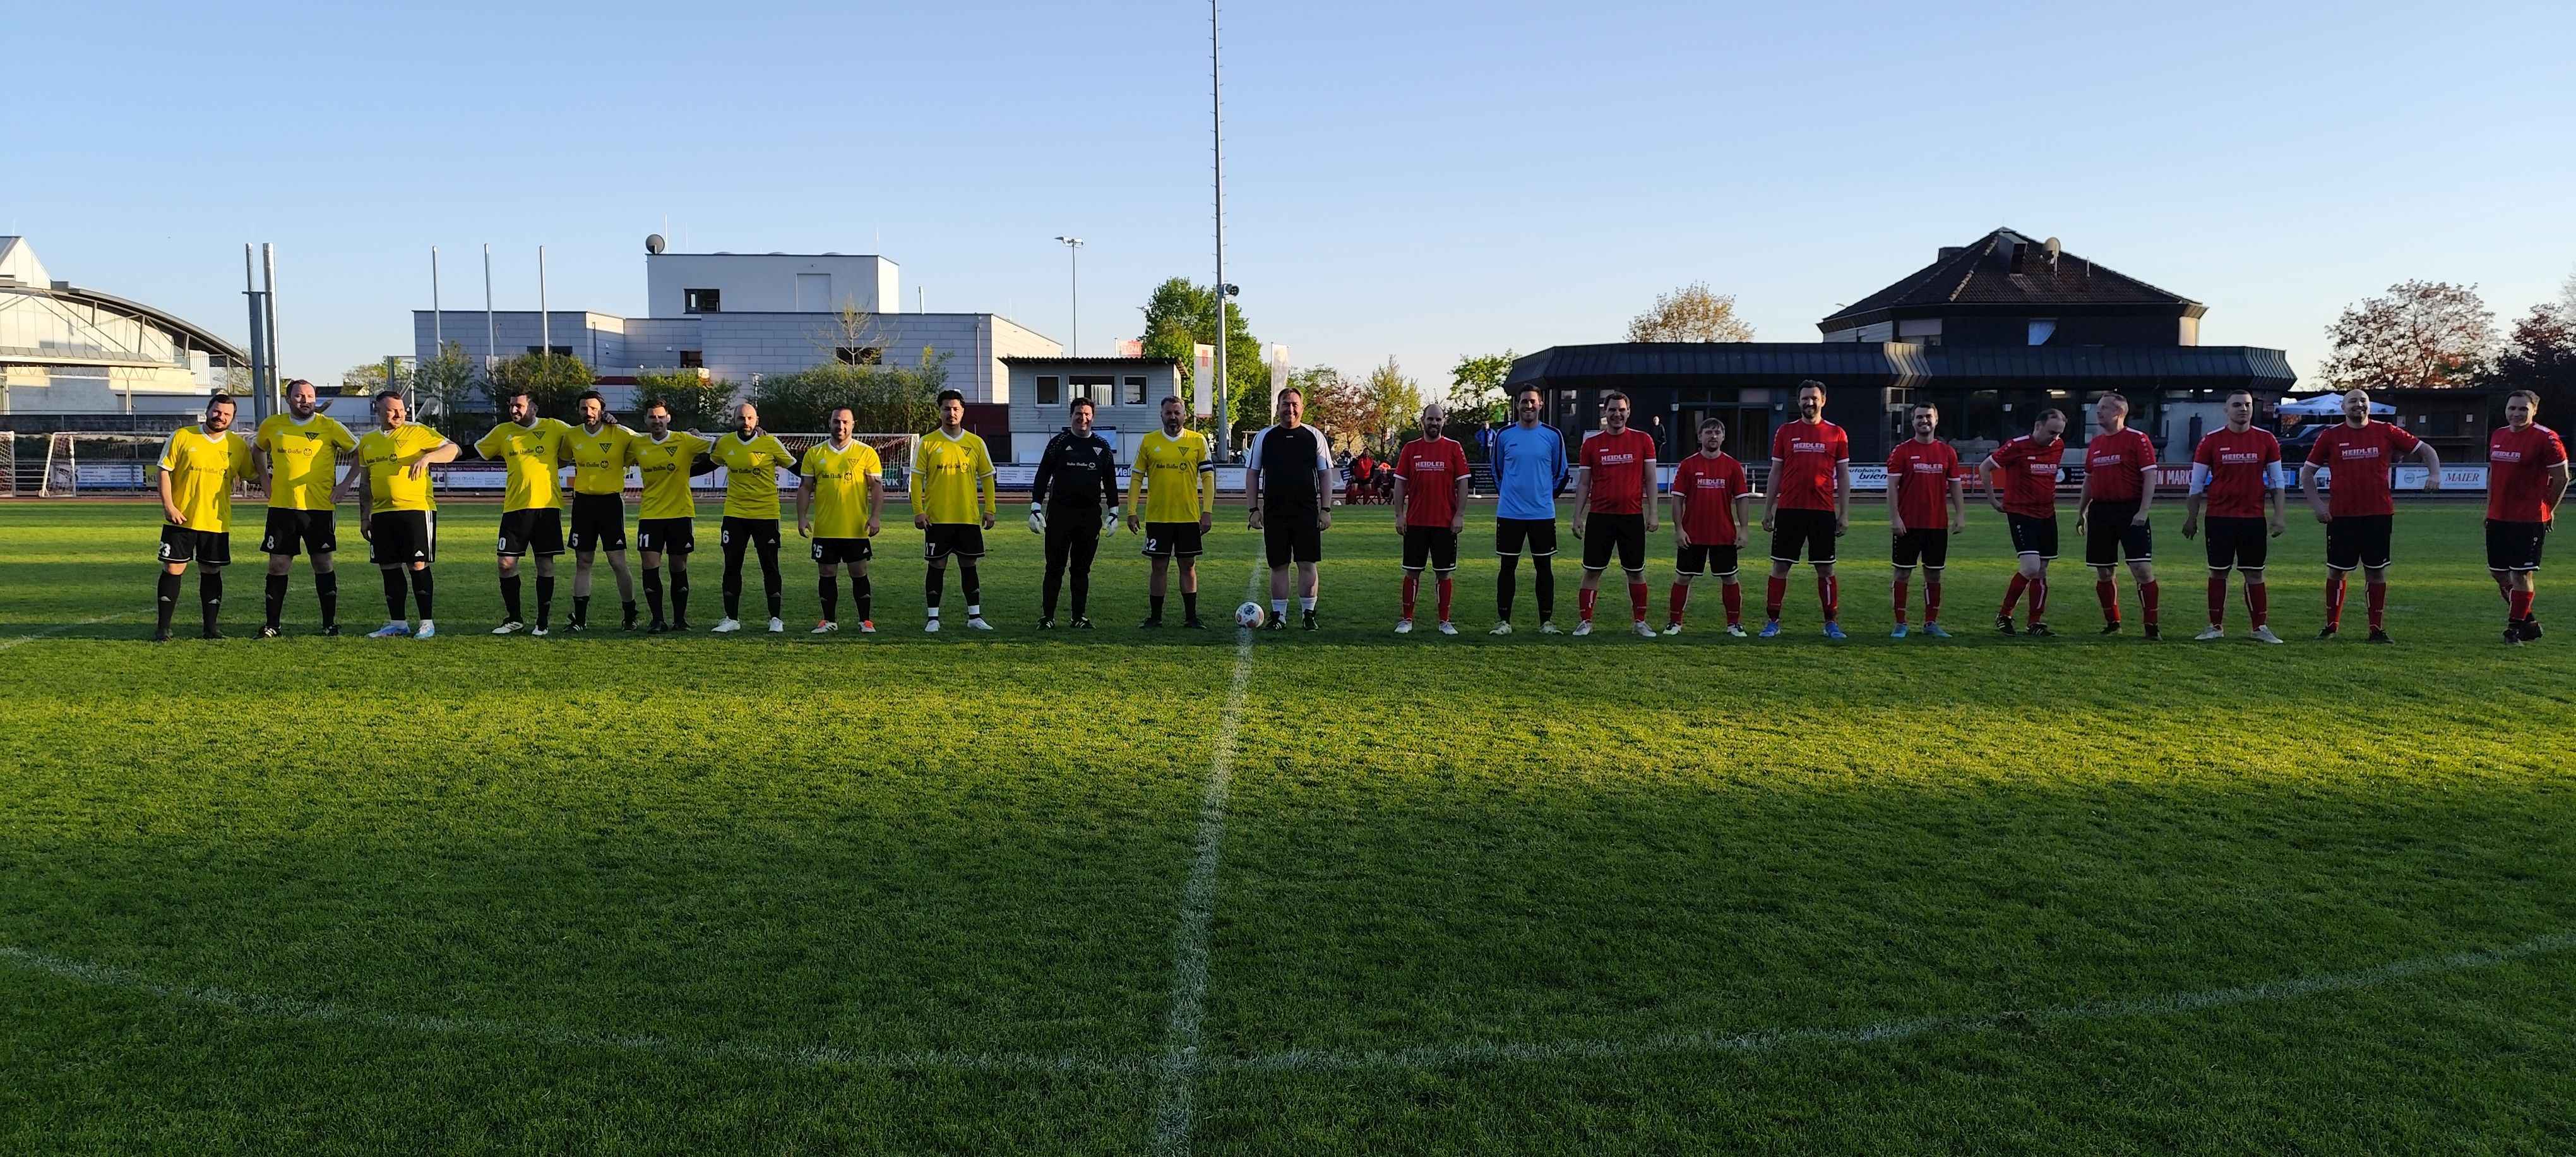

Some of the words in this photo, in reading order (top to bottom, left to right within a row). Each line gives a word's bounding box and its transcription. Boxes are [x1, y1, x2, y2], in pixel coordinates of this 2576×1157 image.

[2342, 447, 2379, 456] HEIDLER
[2491, 450, 2521, 459] HEIDLER
[2167, 469, 2192, 486] MARK
[2445, 472, 2480, 482] MAIER
[266, 535, 275, 549] 8
[498, 537, 506, 551] 0
[572, 532, 579, 547] 5
[639, 533, 650, 548] 11
[722, 530, 729, 544] 6
